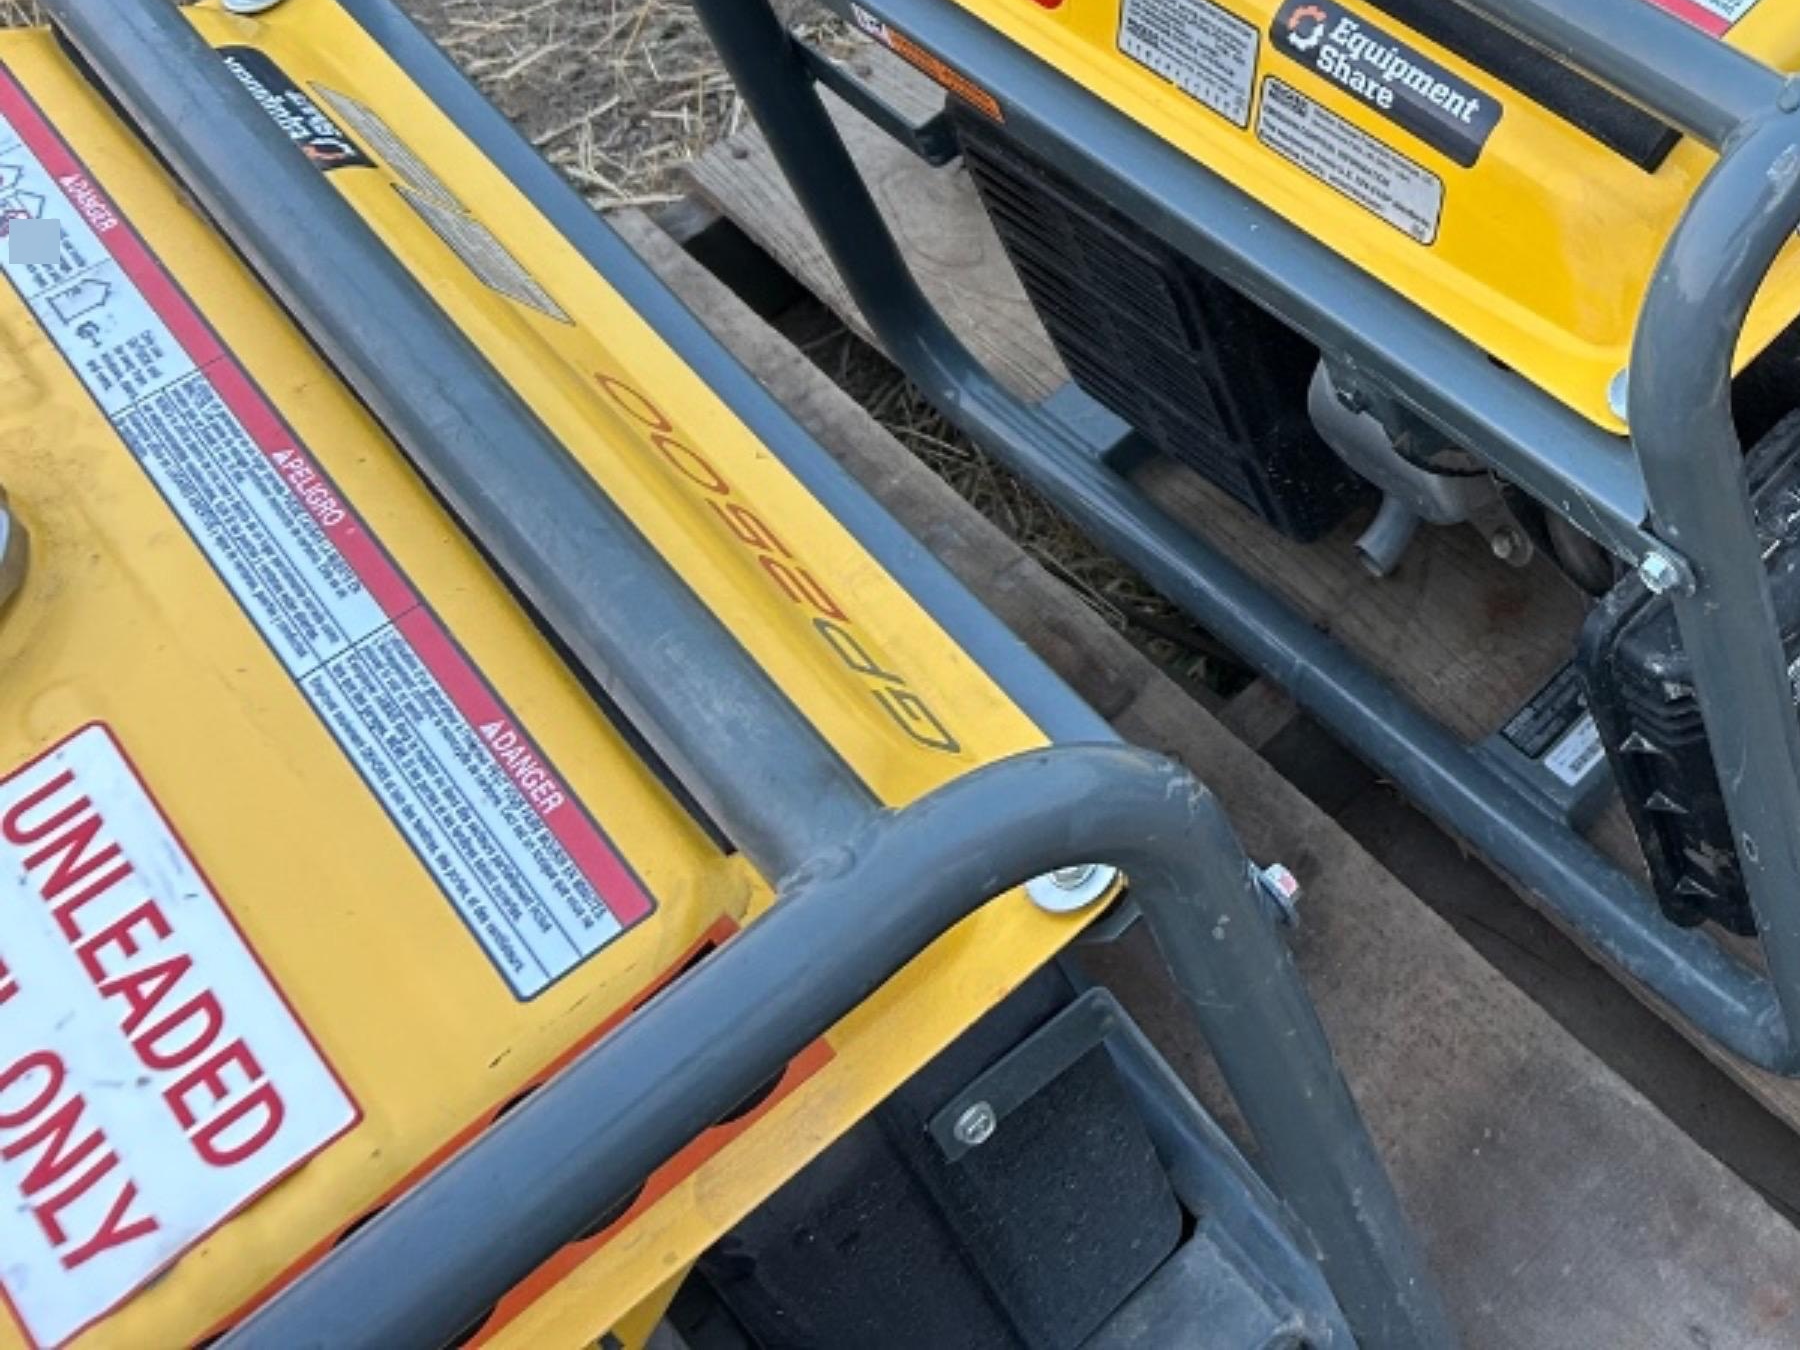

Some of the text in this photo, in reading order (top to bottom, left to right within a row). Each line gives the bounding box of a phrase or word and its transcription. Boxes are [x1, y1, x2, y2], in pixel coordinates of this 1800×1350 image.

[1315, 43, 1394, 110] Share
[1328, 17, 1480, 124] Equipment
[278, 457, 346, 527] PELIGRO
[594, 372, 962, 754] GP2500
[493, 725, 567, 816] DANGER
[2, 768, 286, 1168] UNLEADED
[0, 1049, 161, 1271] ONLY
